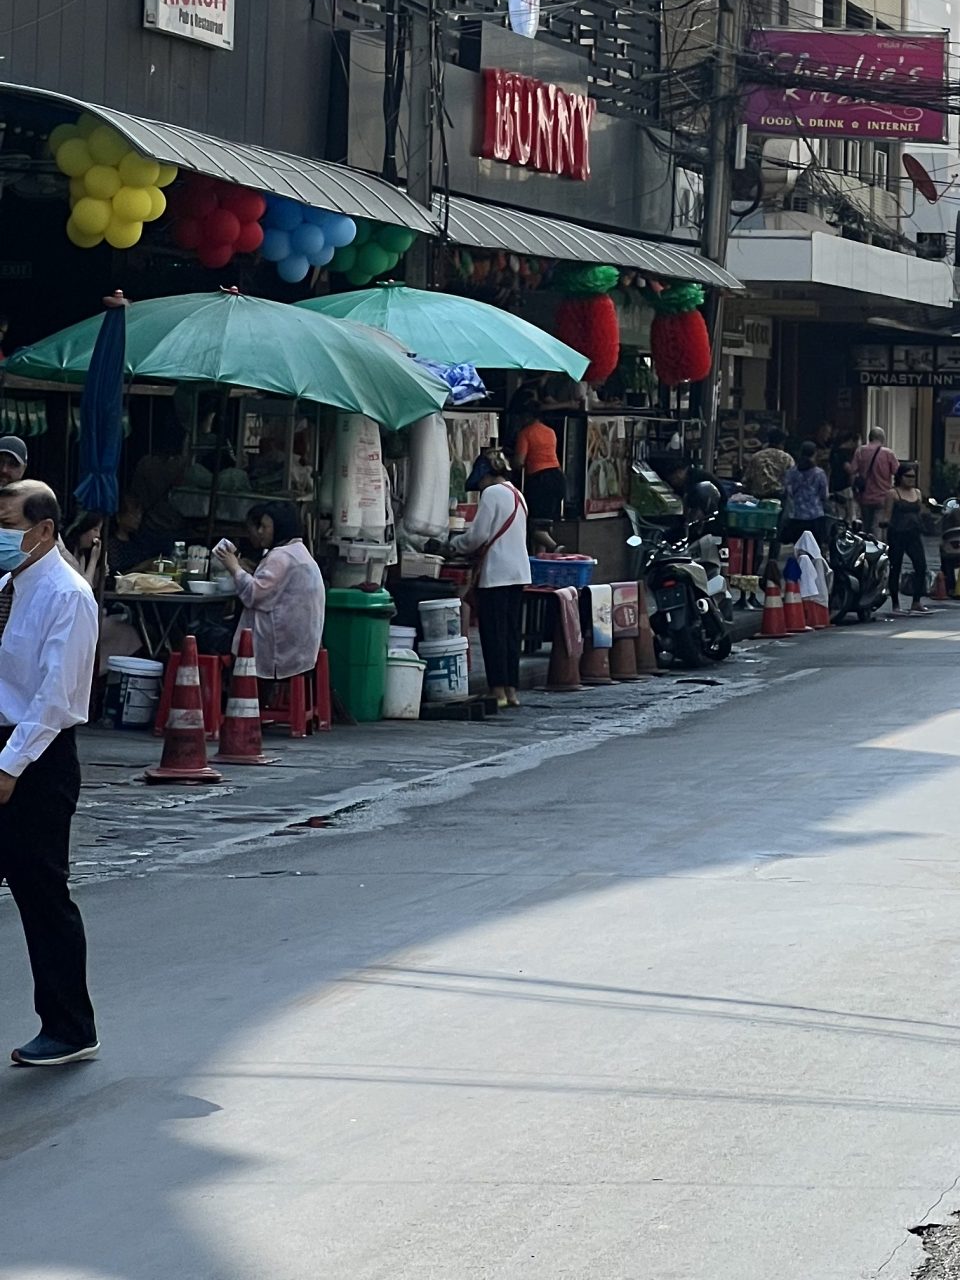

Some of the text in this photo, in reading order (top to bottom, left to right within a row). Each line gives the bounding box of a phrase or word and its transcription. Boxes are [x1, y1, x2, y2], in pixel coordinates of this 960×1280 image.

[484, 68, 597, 182] BUNNY
[761, 116, 920, 132] FOOD DRINK INTERNET
[860, 371, 953, 385] DYNASTY INN
